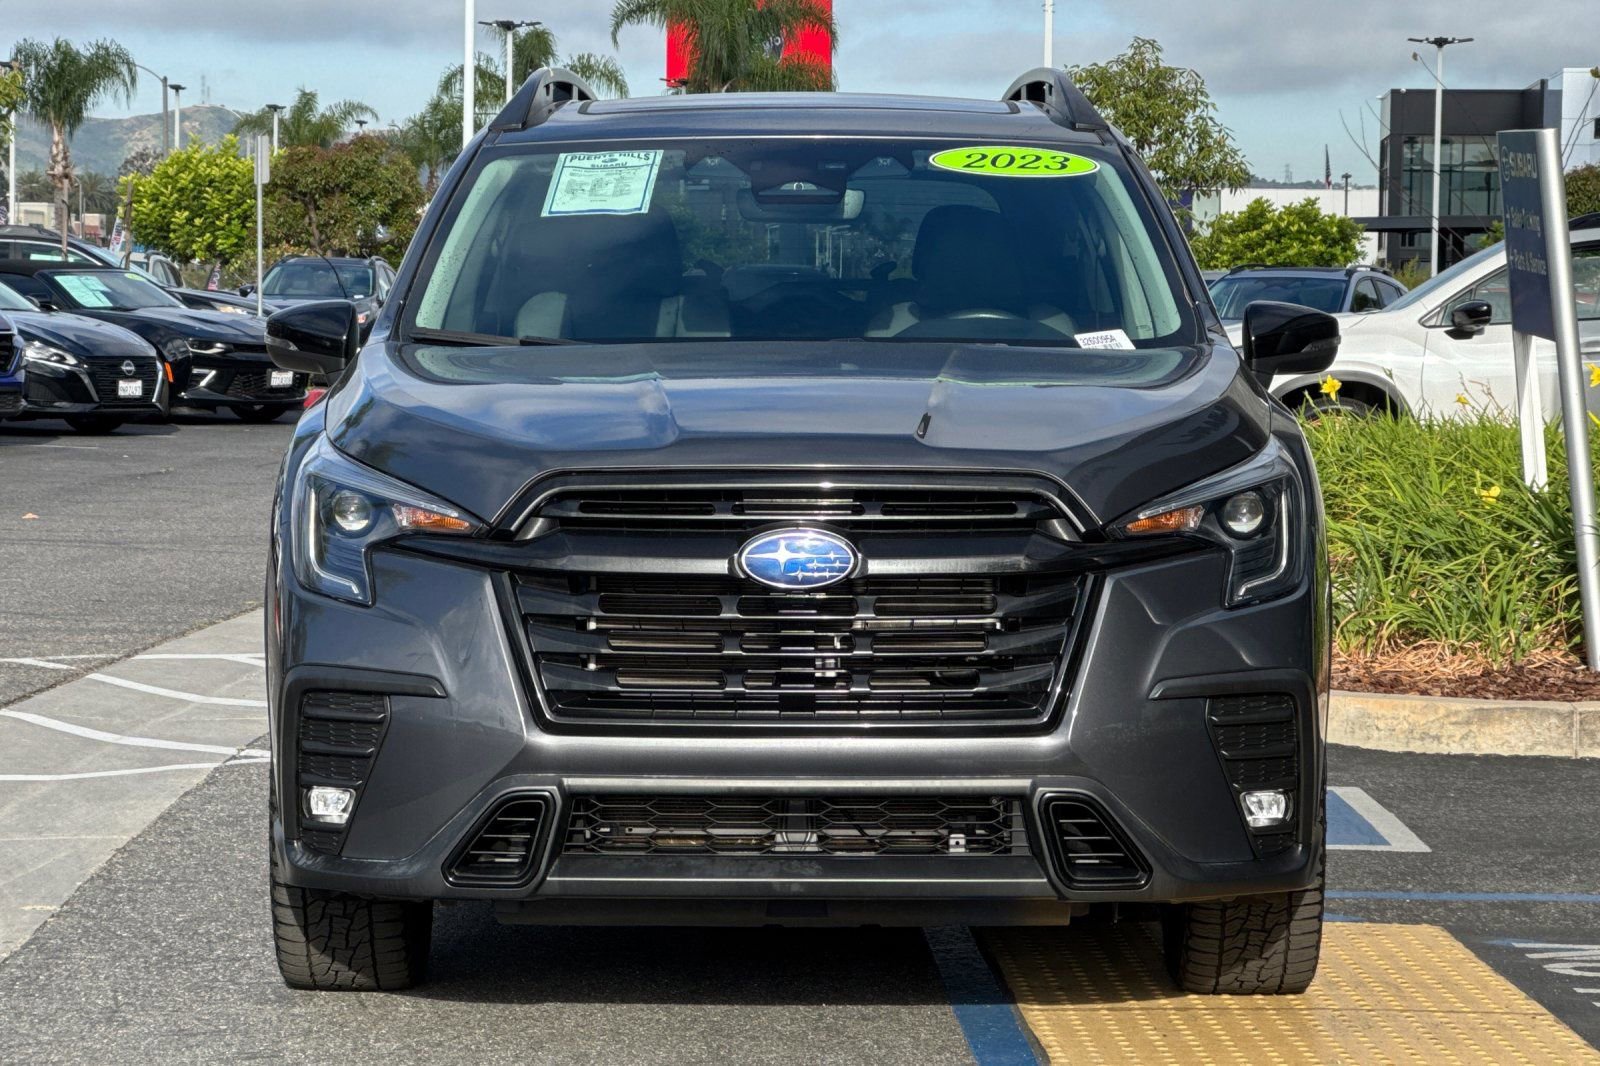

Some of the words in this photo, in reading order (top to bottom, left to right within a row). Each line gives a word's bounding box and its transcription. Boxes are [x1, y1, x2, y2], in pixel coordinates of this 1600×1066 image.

[619, 152, 651, 161] HILLS
[962, 152, 1071, 171] 2023
[1509, 151, 1538, 179] SUBARU
